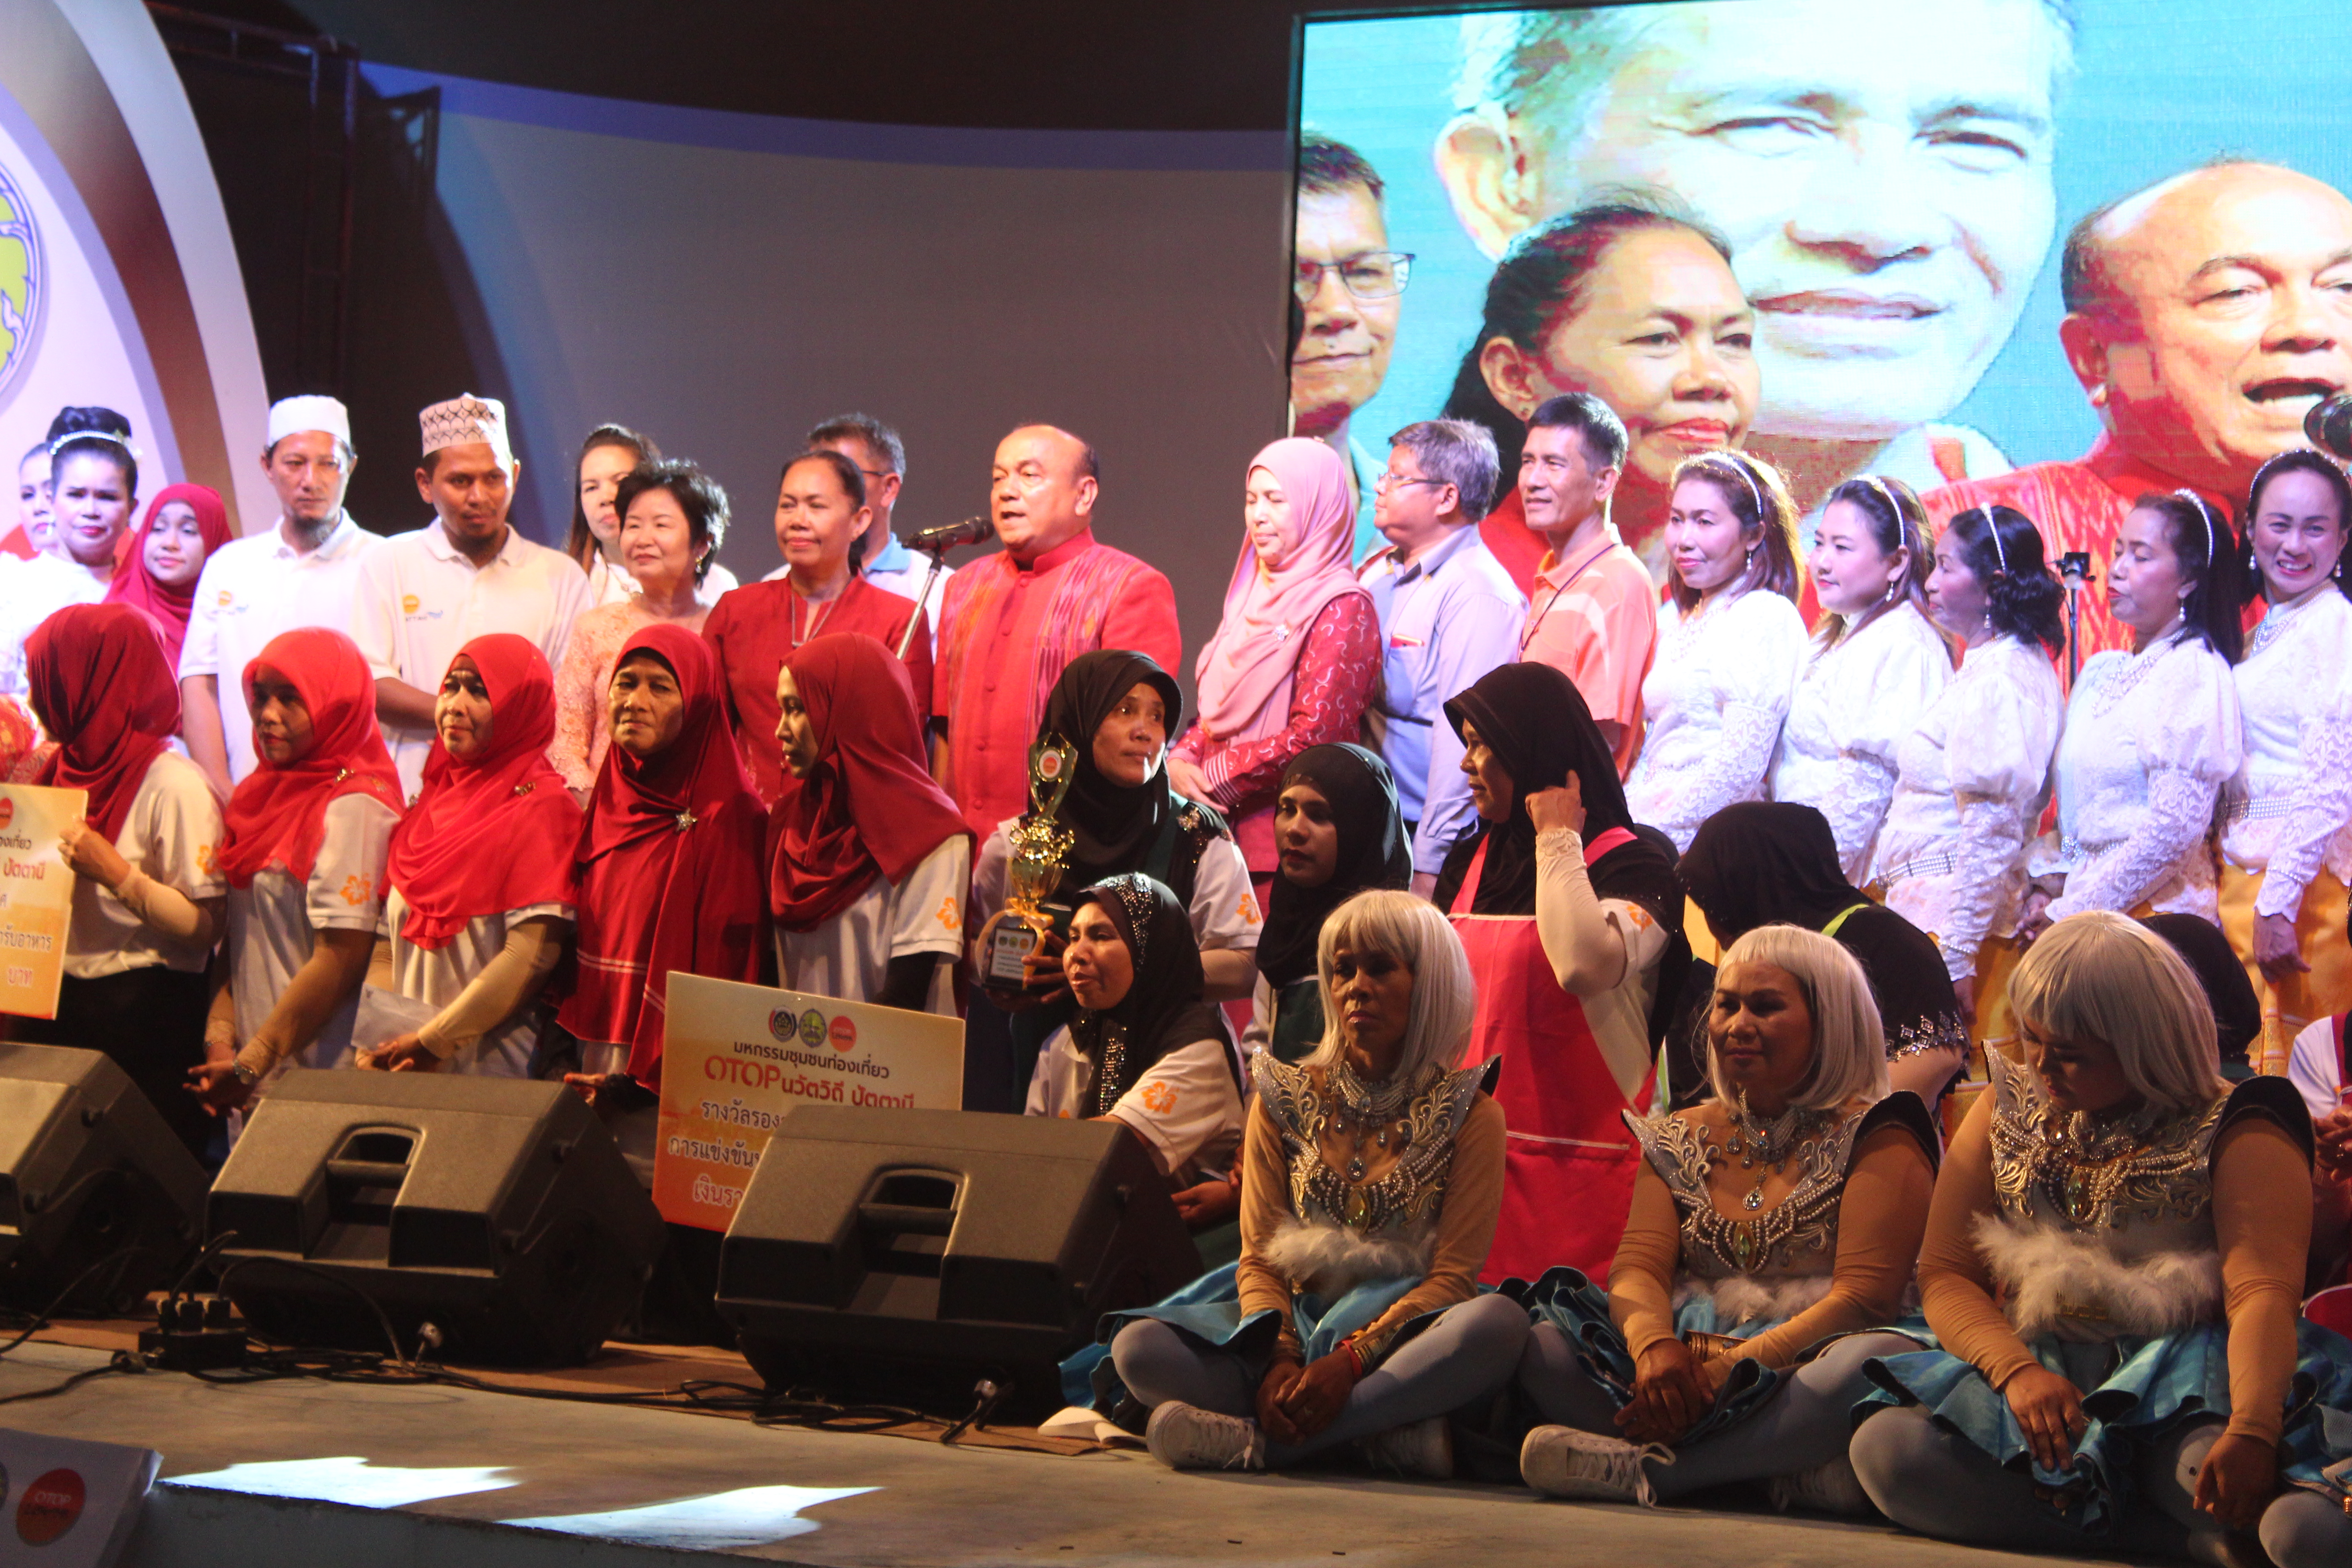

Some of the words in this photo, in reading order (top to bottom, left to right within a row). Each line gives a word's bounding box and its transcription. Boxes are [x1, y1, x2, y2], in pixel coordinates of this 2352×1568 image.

[4, 858, 46, 879] ปัตตานี
[734, 1042, 890, 1078] มหกรรมชุมชนท่องเที่ยว
[702, 1099, 784, 1128] รางวัลรอง
[671, 1138, 760, 1167] การแข่งขัน
